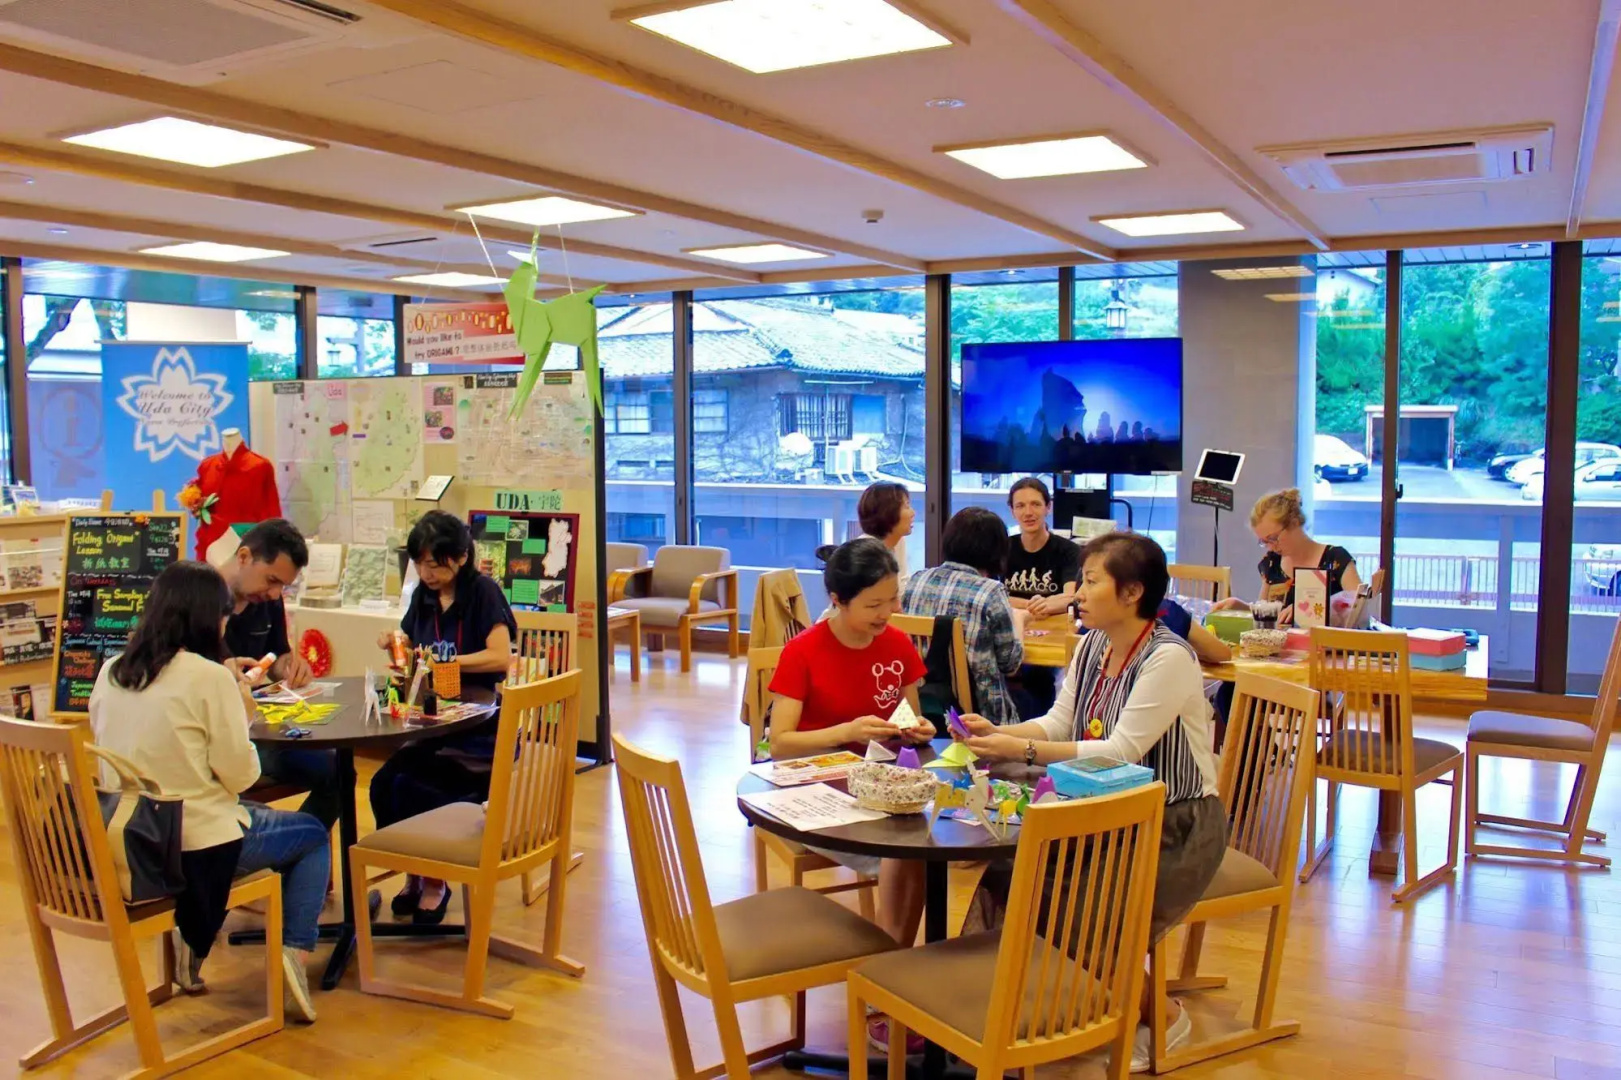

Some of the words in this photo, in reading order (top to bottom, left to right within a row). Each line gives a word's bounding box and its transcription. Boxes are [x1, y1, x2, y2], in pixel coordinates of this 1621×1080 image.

[407, 336, 425, 346] Would
[427, 335, 439, 344] you
[440, 331, 452, 342] like
[454, 331, 462, 340] to
[415, 351, 425, 359] try
[427, 347, 453, 358] ORIGAMI
[140, 389, 194, 400] Welcome
[141, 401, 171, 414] Uda
[179, 401, 212, 418] City
[73, 531, 103, 547] Folding
[96, 588, 112, 600] Free
